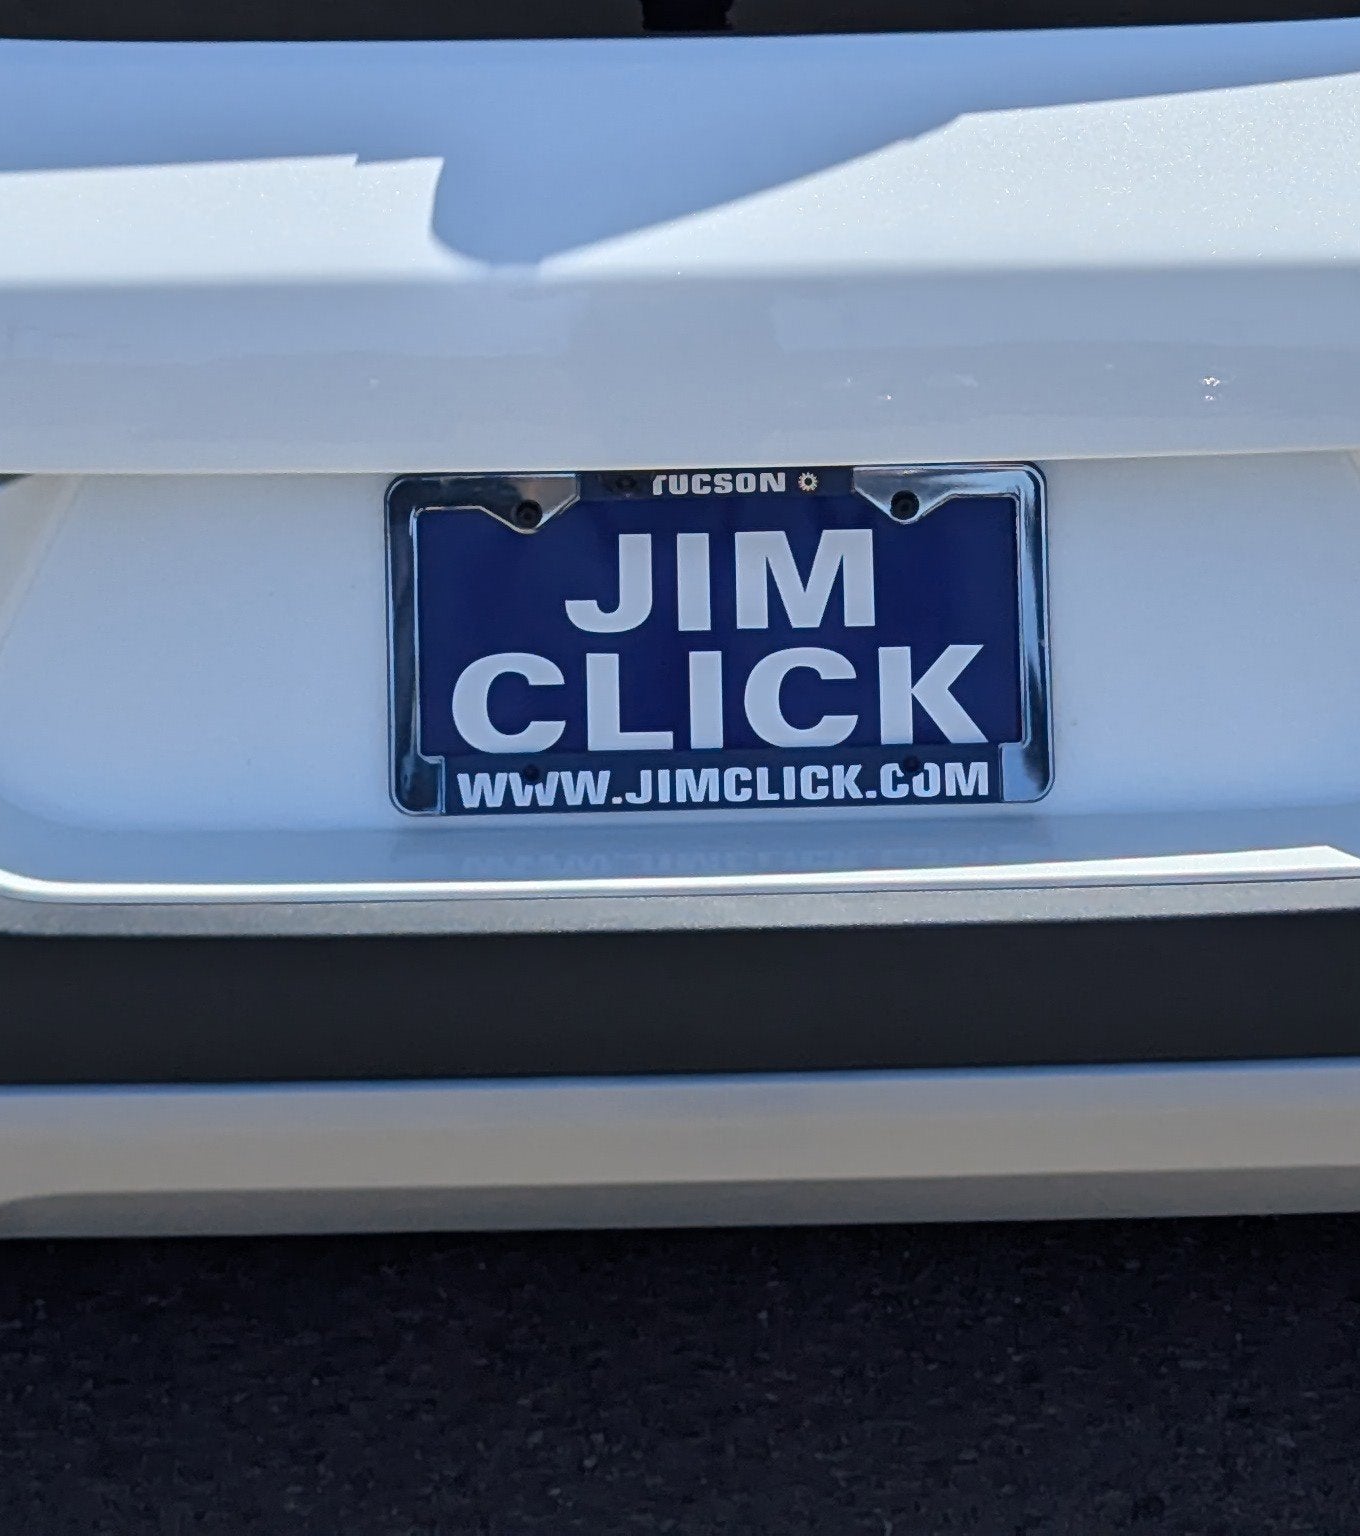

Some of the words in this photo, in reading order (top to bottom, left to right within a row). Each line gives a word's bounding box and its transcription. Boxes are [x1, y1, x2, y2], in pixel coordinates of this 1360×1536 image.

[652, 472, 786, 496] TUCSON
[565, 528, 876, 633] JIM
[451, 644, 989, 754] CLICK
[456, 761, 989, 809] WWW.JIMCLICK.COM
